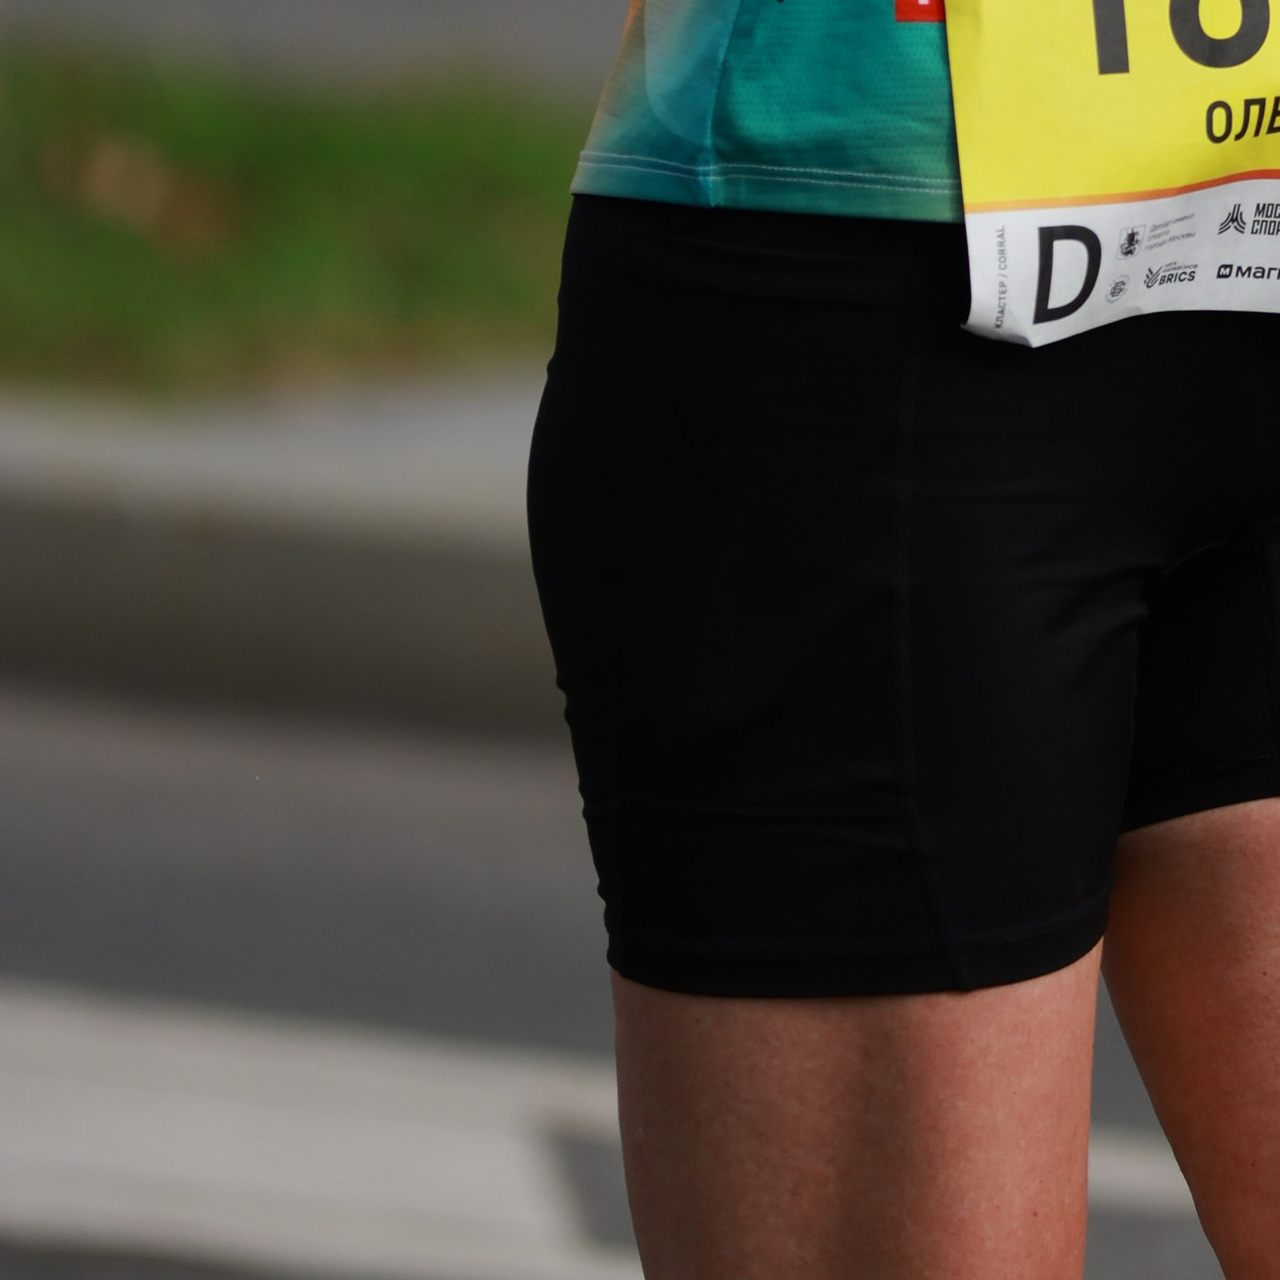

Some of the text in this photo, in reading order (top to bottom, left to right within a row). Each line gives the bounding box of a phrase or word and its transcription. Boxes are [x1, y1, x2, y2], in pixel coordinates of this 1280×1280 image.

[996, 226, 1007, 271] CORRAL
[1033, 225, 1102, 325] D
[1158, 271, 1196, 286] BRICS
[994, 281, 1007, 329] КЛАСТЕР
